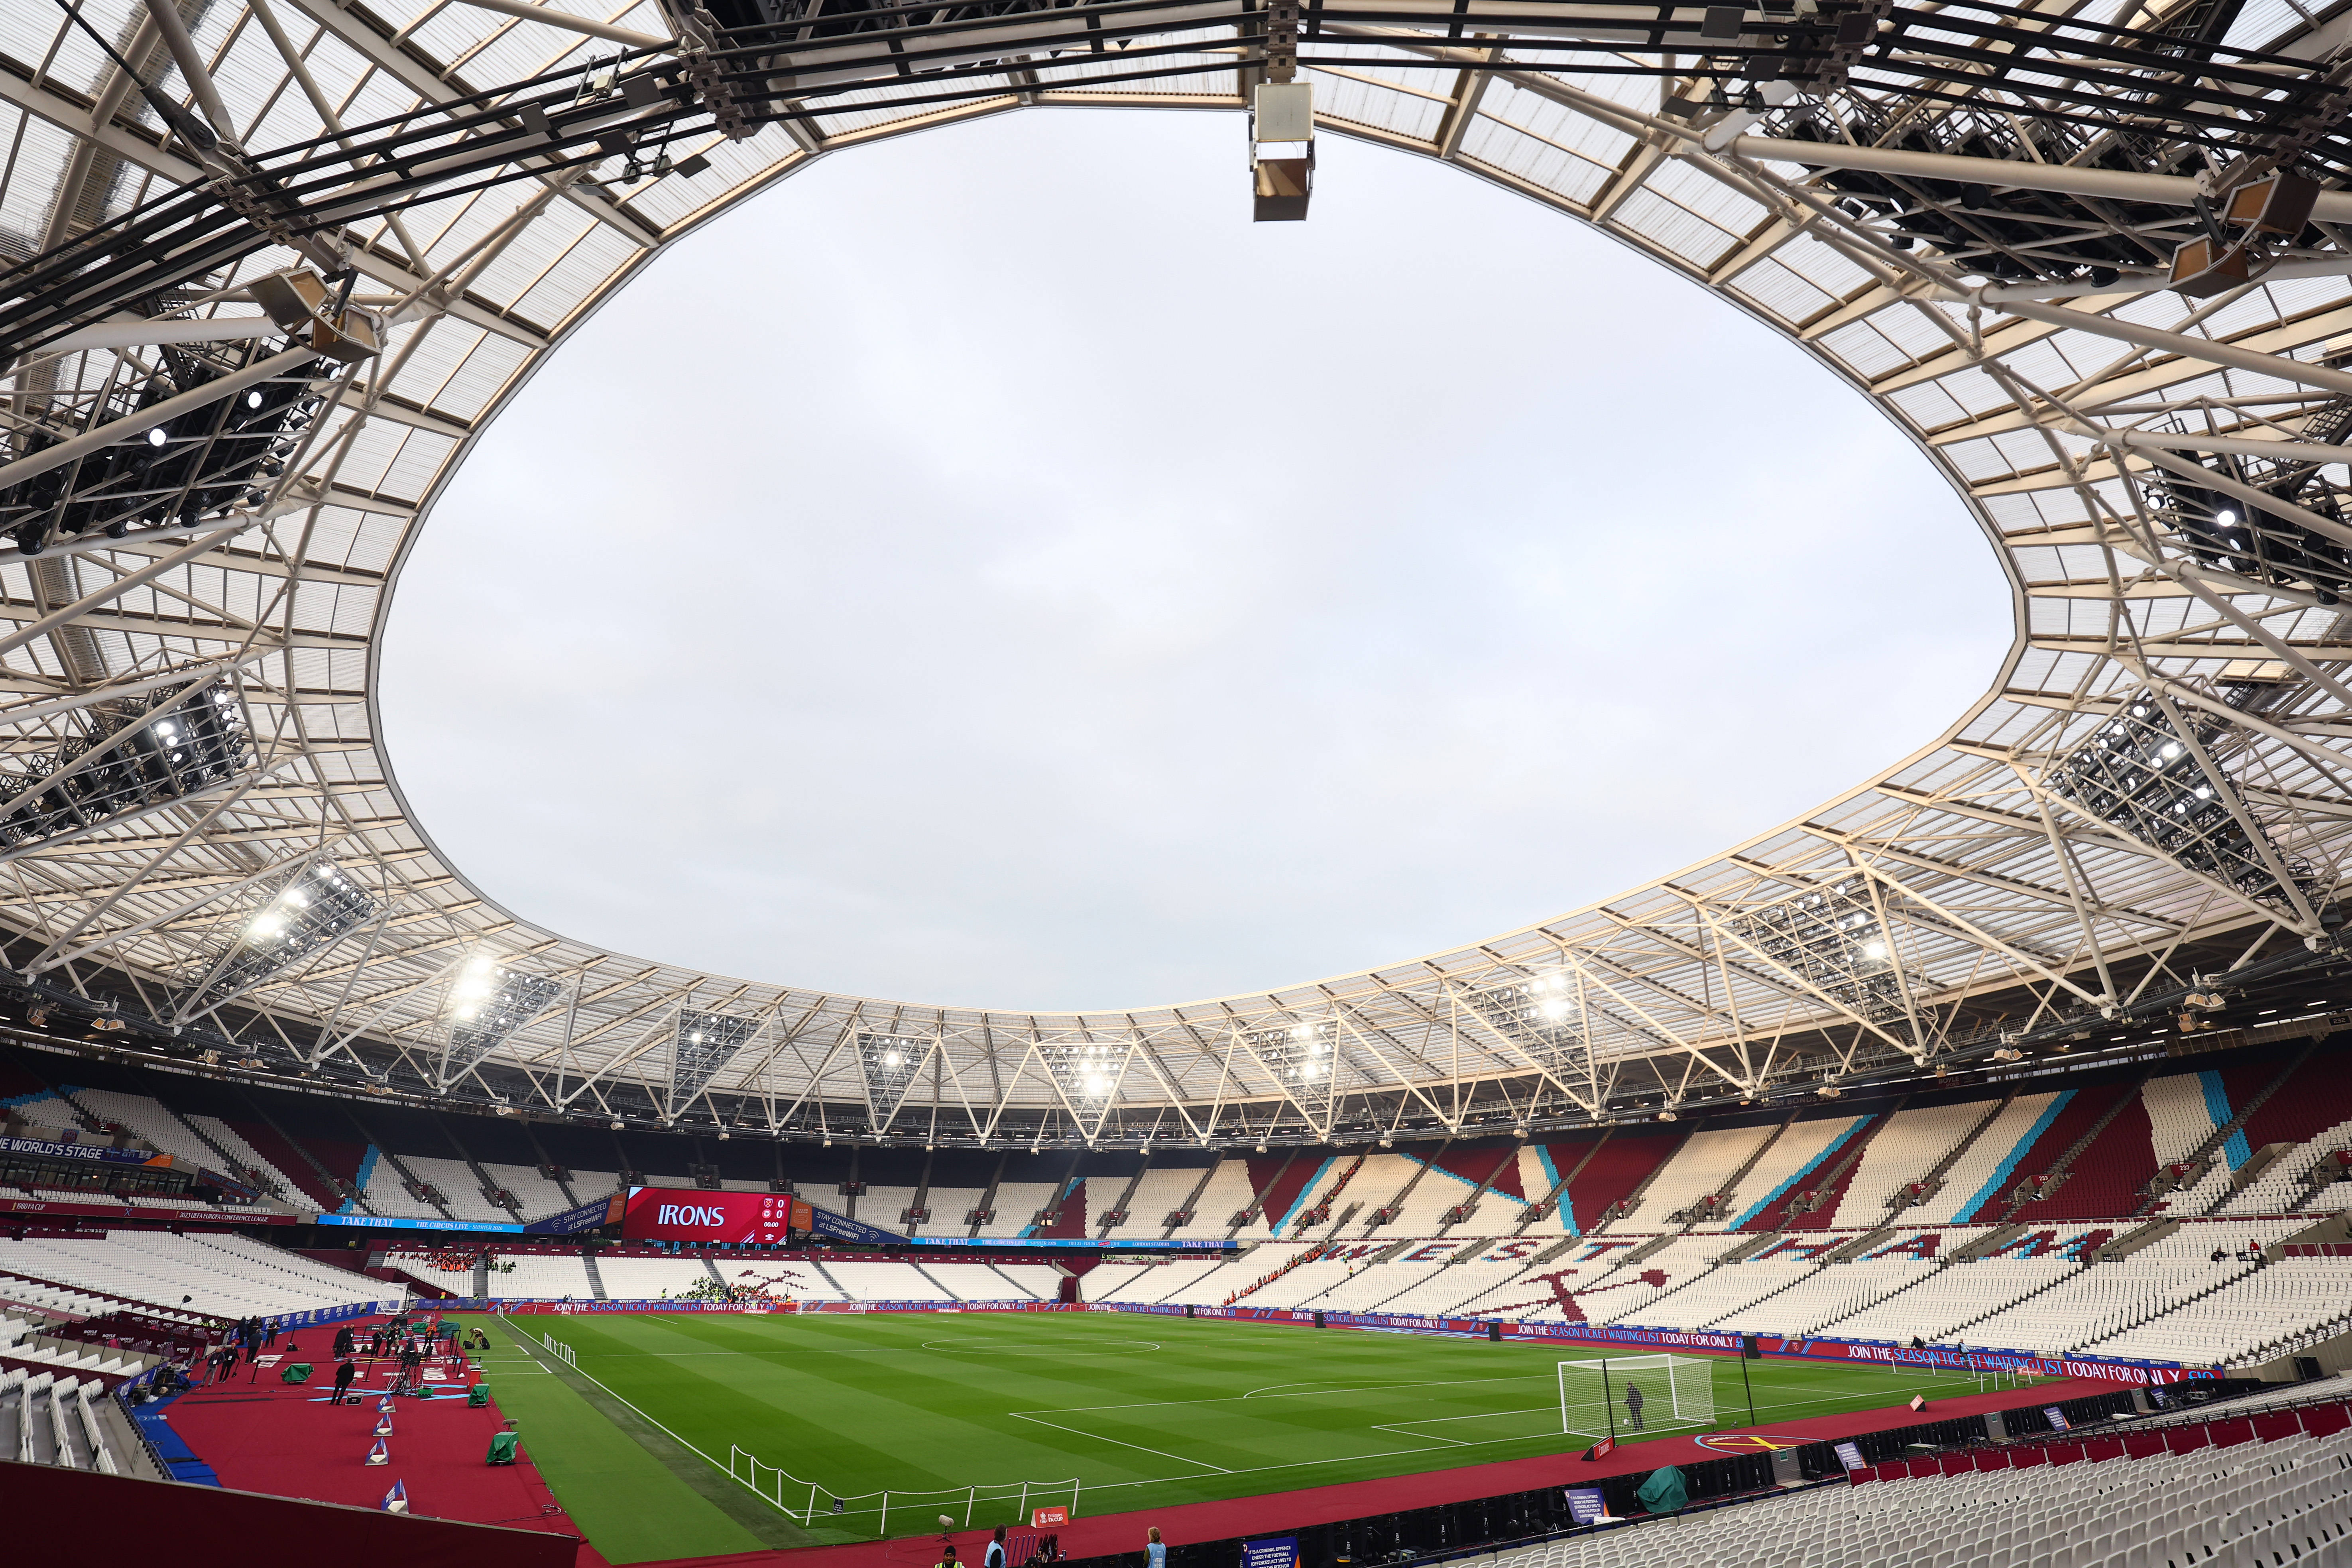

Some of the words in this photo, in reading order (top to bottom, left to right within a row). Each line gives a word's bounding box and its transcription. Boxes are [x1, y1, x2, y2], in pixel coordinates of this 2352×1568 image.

[11, 1139, 63, 1155] WORLD'S
[64, 1146, 103, 1159] STAGE
[200, 1170, 225, 1184] CLARET
[225, 1181, 239, 1190] AND
[240, 1186, 260, 1198] HUGH
[563, 1213, 577, 1224] STAY
[577, 1202, 606, 1218] CONNECTED
[776, 1210, 783, 1218] 0
[777, 1200, 784, 1208] 0
[341, 1216, 368, 1226] TAKE
[368, 1218, 395, 1228] THAT
[658, 1204, 725, 1226] IRONS
[816, 1212, 832, 1222] STAY
[832, 1217, 867, 1234] CONNECTED
[552, 1303, 572, 1312] JOIN
[1336, 1314, 1355, 1323] TICKET
[1355, 1316, 1377, 1324] WAITING
[1389, 1318, 1409, 1326] TODAY
[1409, 1318, 1421, 1327] FOR
[1422, 1319, 1438, 1328] ONLY
[1440, 1321, 1449, 1329] £10
[1517, 1325, 1534, 1334] JOIN
[1534, 1326, 1549, 1335] THE
[1550, 1326, 1580, 1338] SEASON
[1581, 1328, 1608, 1340] TICKET
[1608, 1330, 1642, 1342] WAITING
[1643, 1332, 1660, 1342] LIST
[1661, 1333, 1690, 1345] TODAY
[1690, 1334, 1709, 1346] FOR
[1710, 1336, 1733, 1348] ONLY
[1736, 1337, 1744, 1348] £1
[1848, 1345, 1871, 1359] JOIN
[1873, 1347, 1892, 1360] THE
[1893, 1348, 1940, 1364] SEASON
[1982, 1355, 2035, 1371] WAITING
[2035, 1359, 2062, 1375] LIST
[2064, 1361, 2107, 1379] TODAY
[2107, 1365, 2134, 1383] FOR
[1599, 1441, 1610, 1456] Emirates
